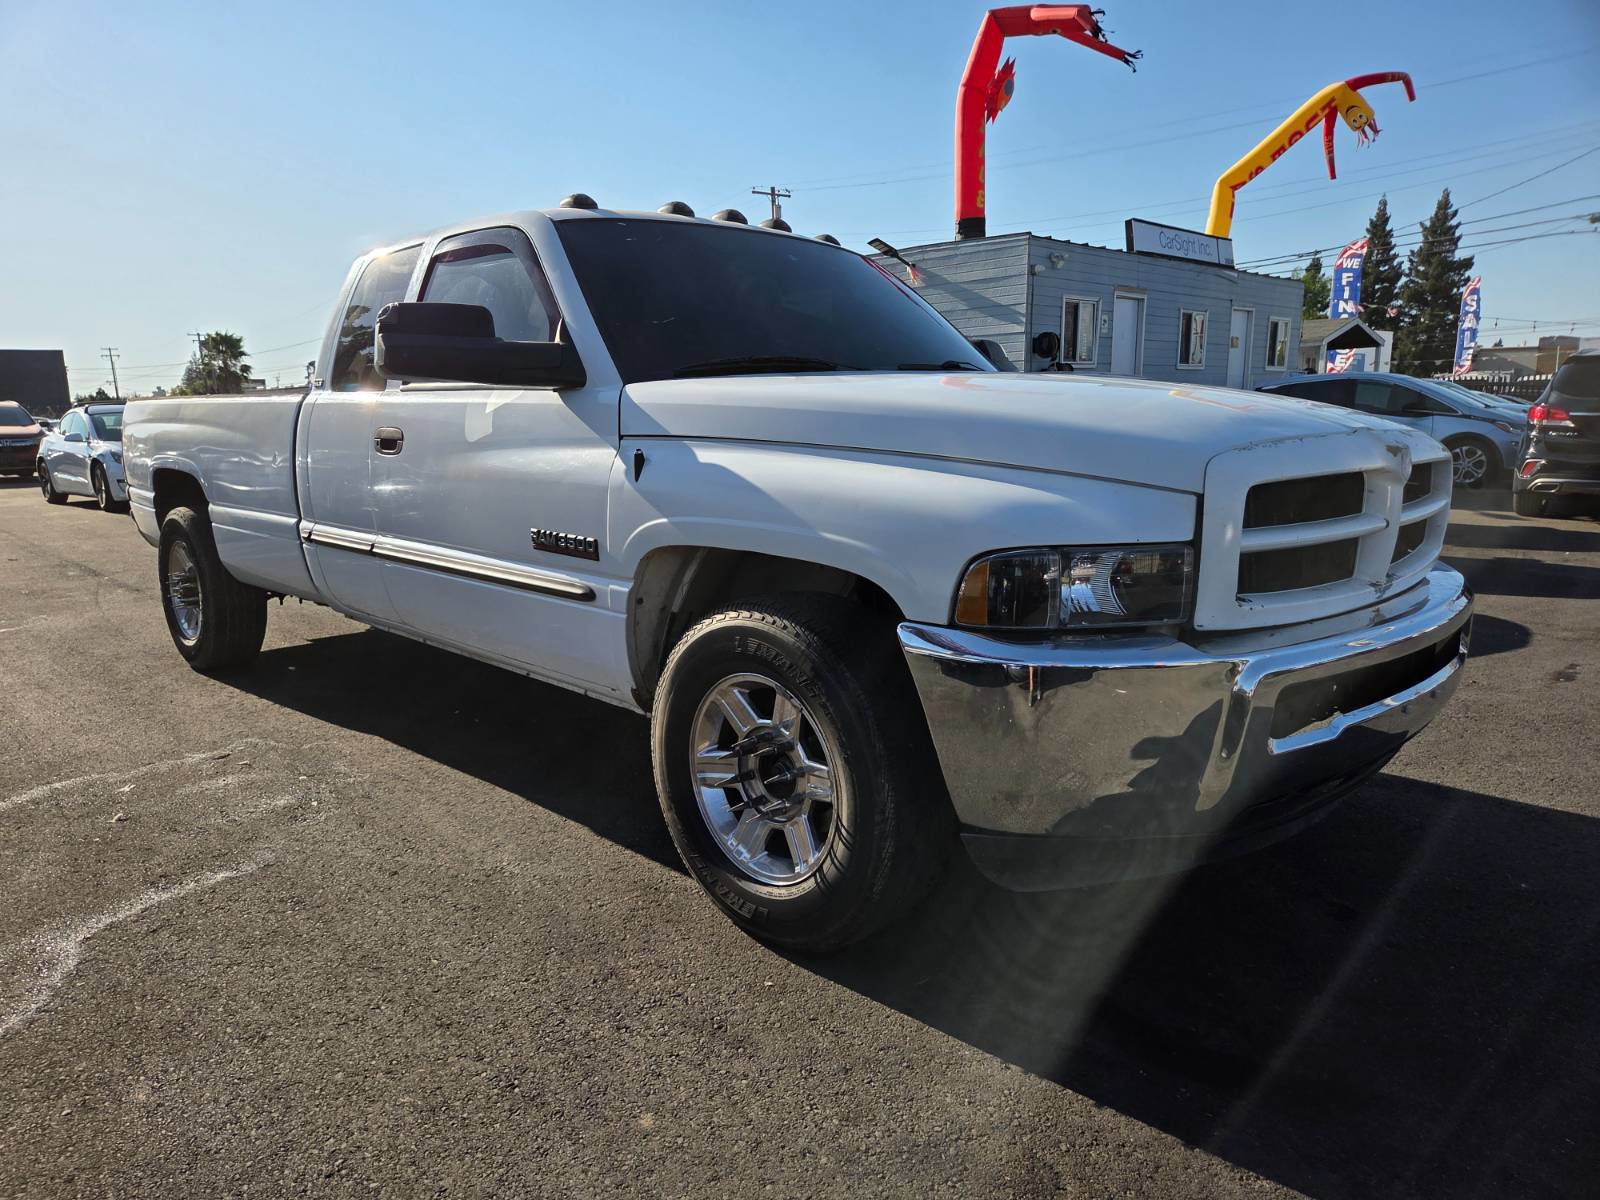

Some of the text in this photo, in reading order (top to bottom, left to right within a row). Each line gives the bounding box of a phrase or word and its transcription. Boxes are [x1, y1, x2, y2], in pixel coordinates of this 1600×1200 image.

[1159, 230, 1213, 257] CarSight Inc.
[1342, 258, 1361, 269] WE
[1460, 294, 1478, 366] SALE
